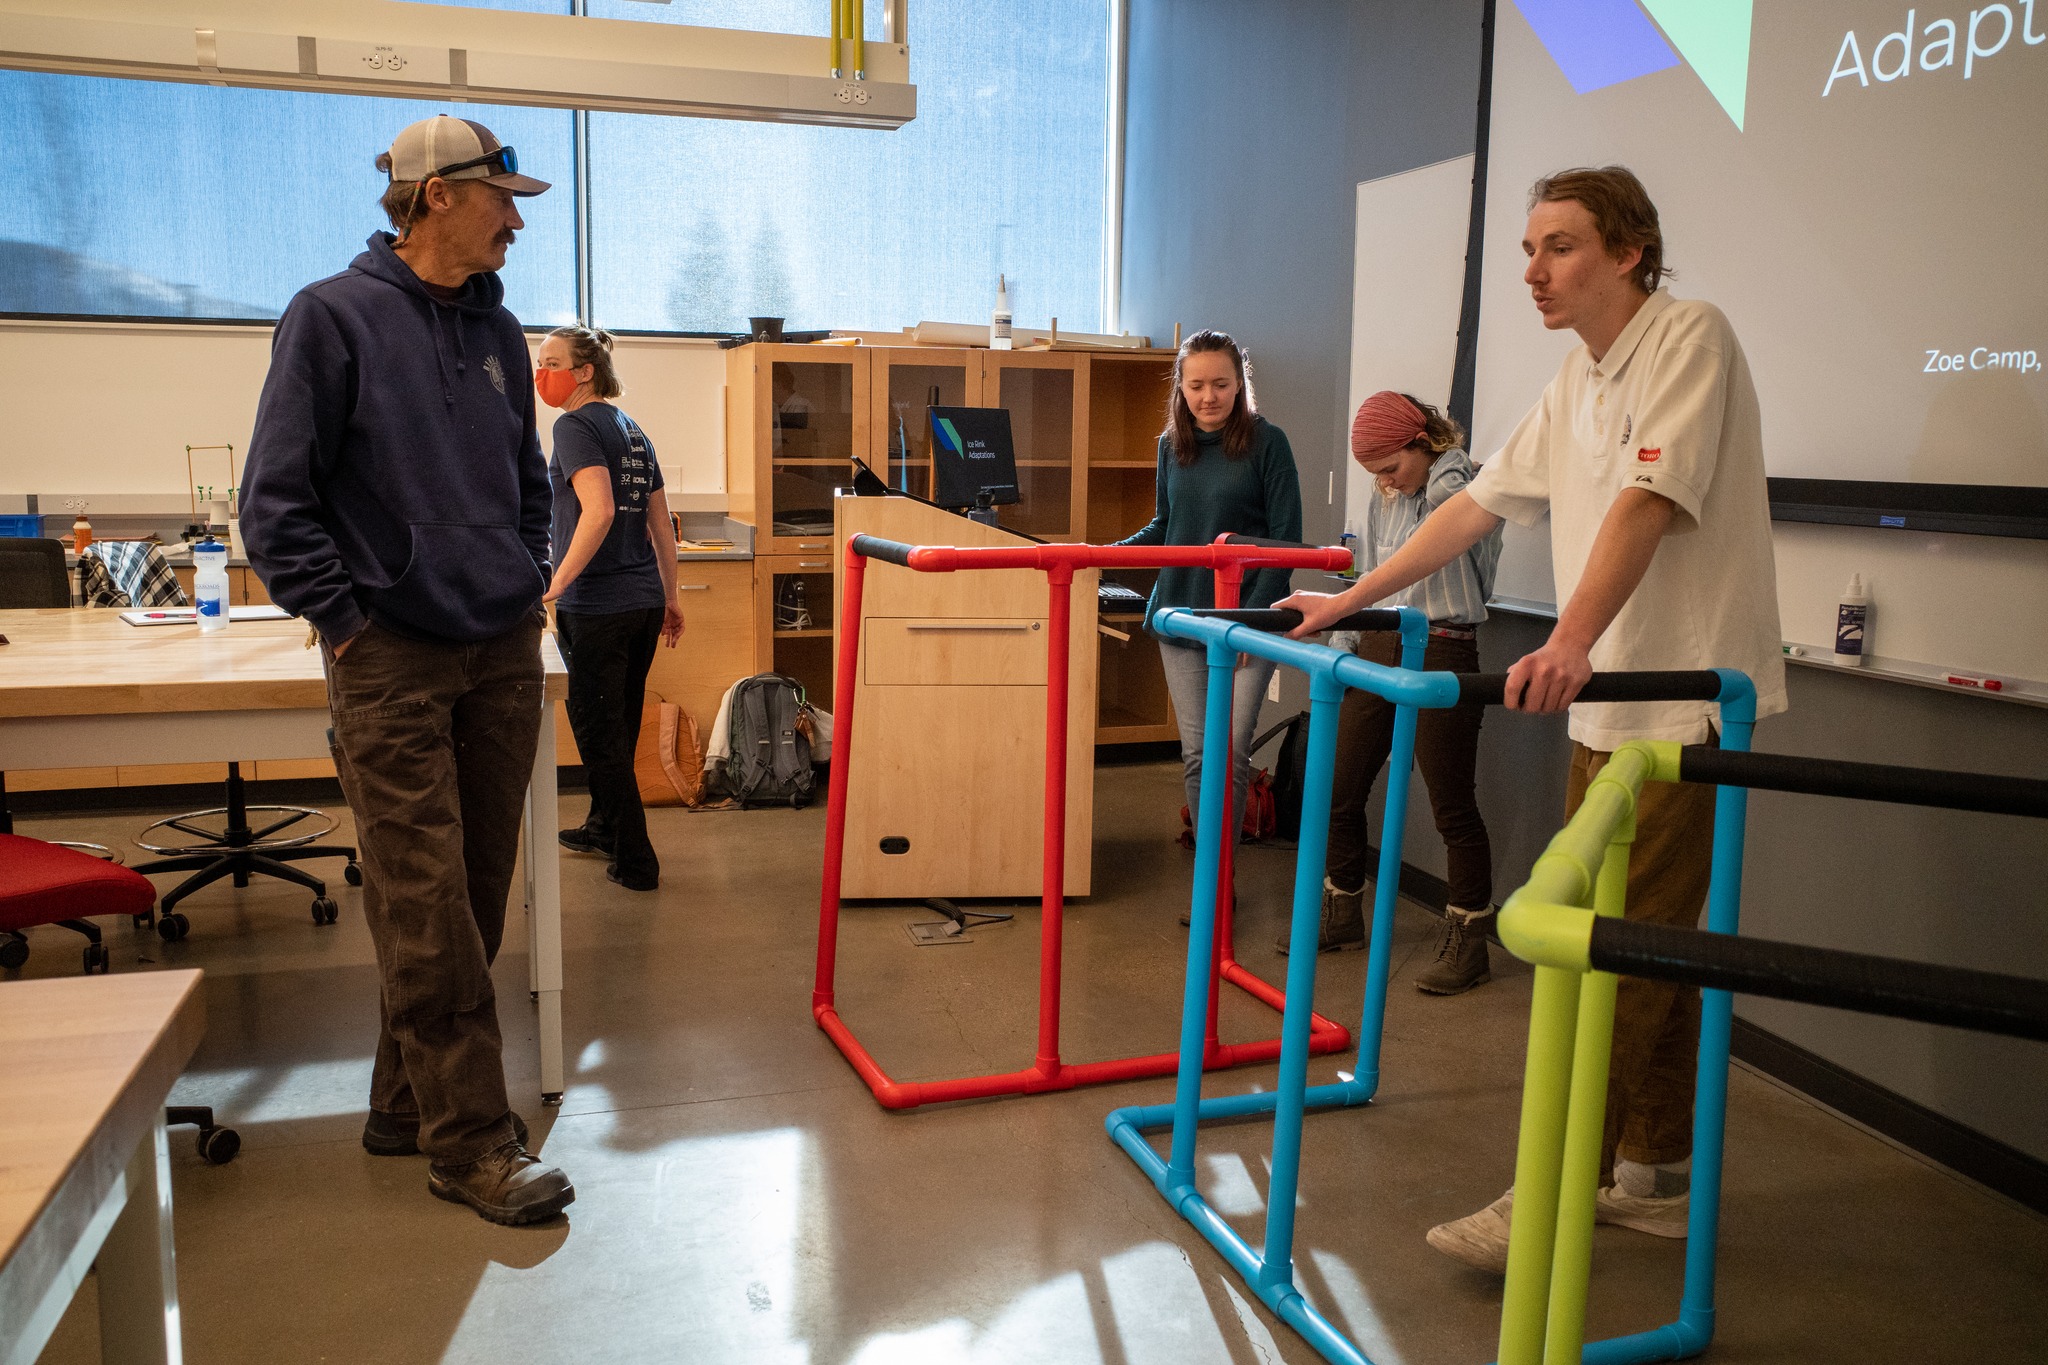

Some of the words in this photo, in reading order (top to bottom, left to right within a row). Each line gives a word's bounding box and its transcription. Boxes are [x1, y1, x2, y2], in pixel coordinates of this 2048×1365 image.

[1922, 349, 1965, 373] Zoe
[1969, 346, 2043, 374] Camp,
[966, 440, 974, 448] Ice
[974, 440, 986, 448] Rink
[968, 450, 996, 460] Adaptations
[620, 473, 631, 482] 32
